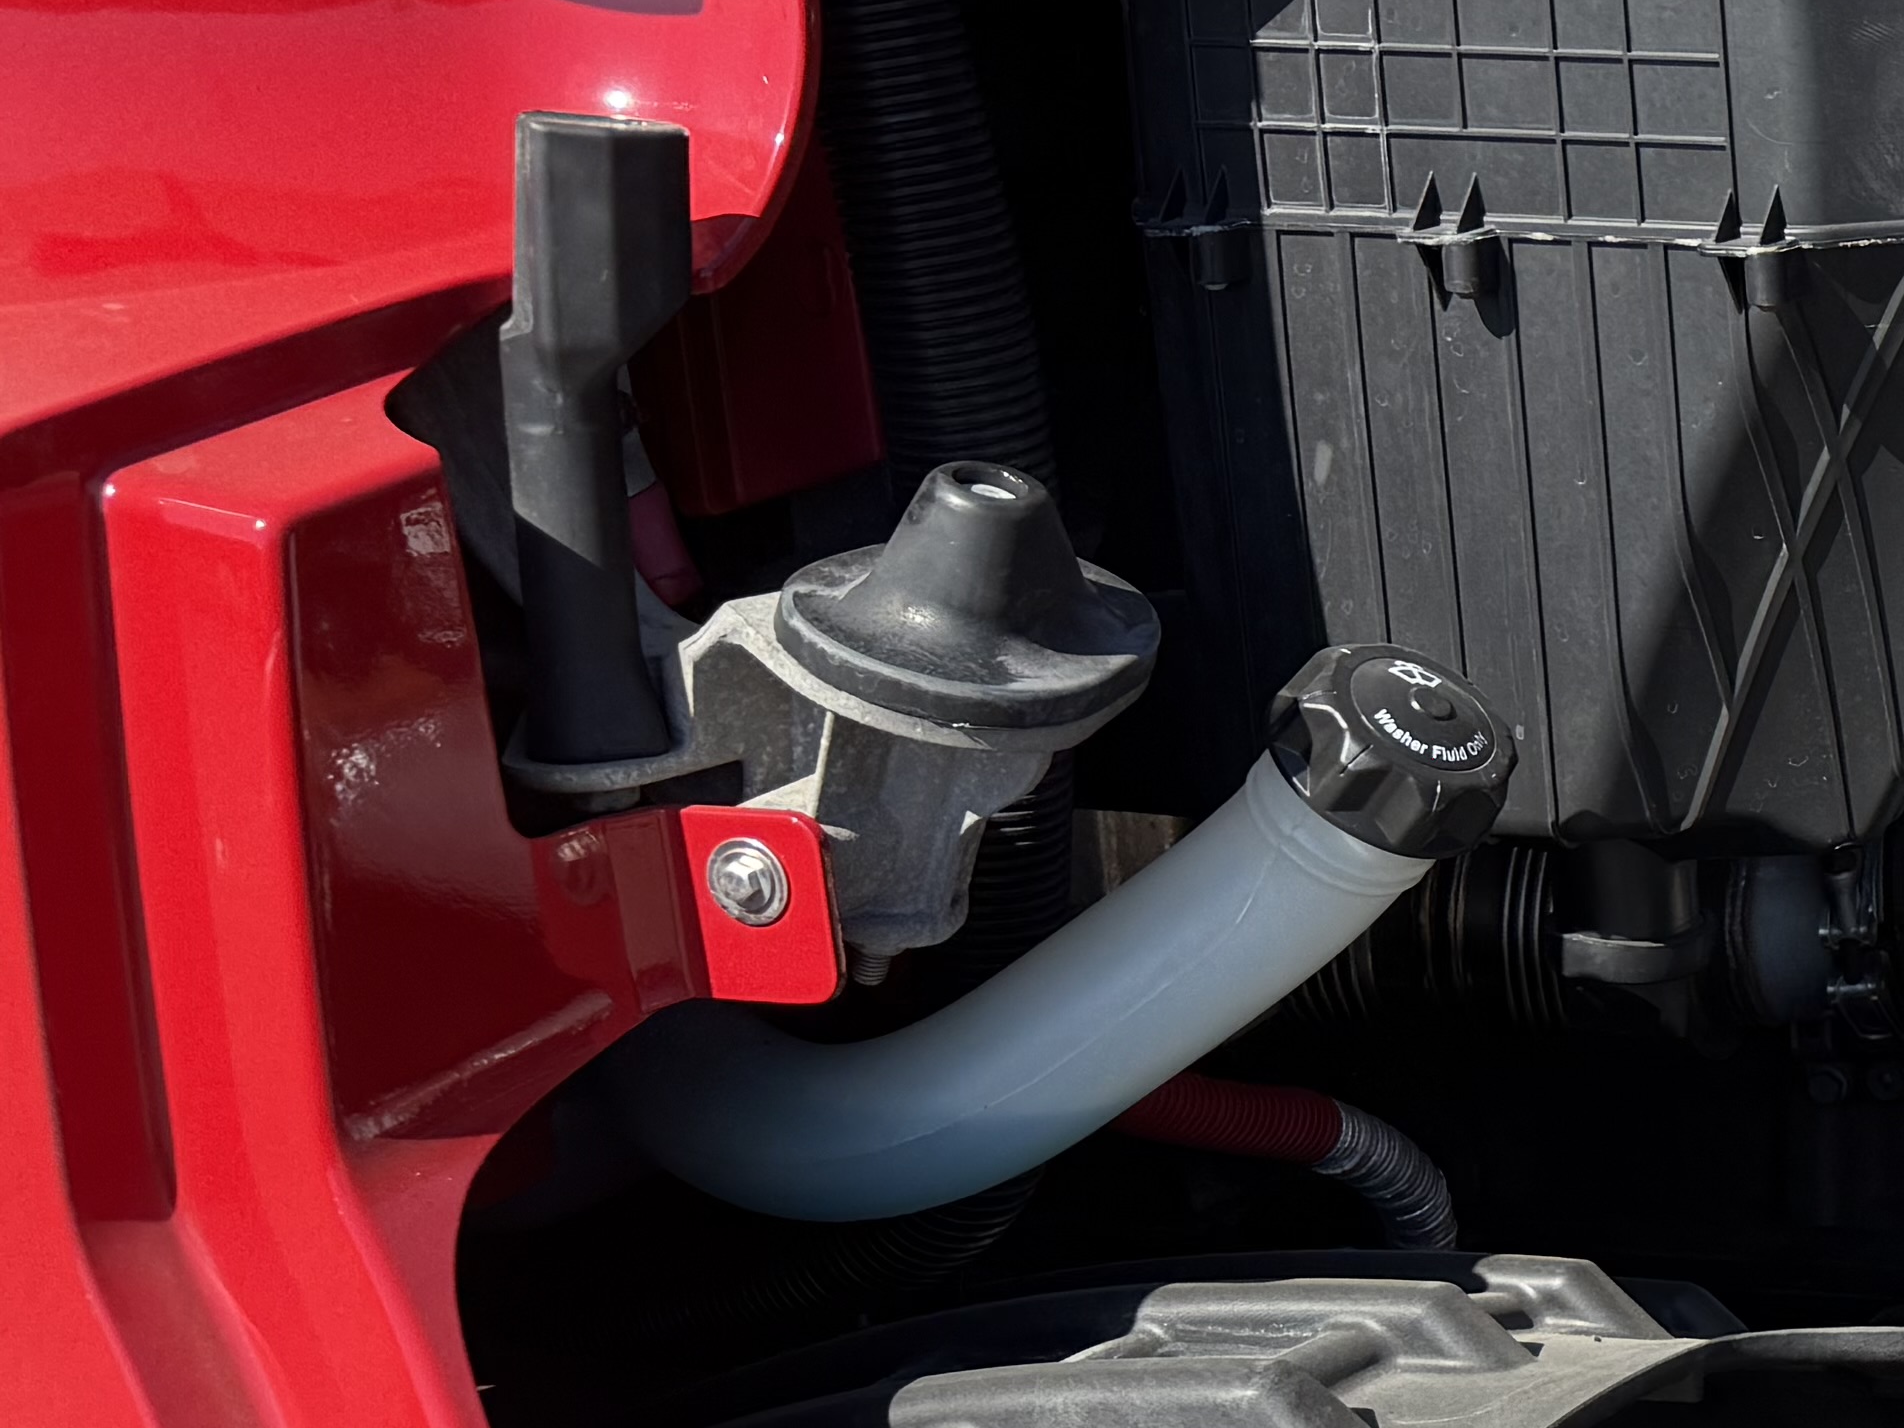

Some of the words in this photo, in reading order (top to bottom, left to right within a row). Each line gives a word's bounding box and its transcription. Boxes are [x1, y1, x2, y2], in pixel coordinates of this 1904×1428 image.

[1374, 708, 1429, 755] Washer
[1431, 744, 1468, 762] Fluid
[1466, 730, 1488, 756] Only
